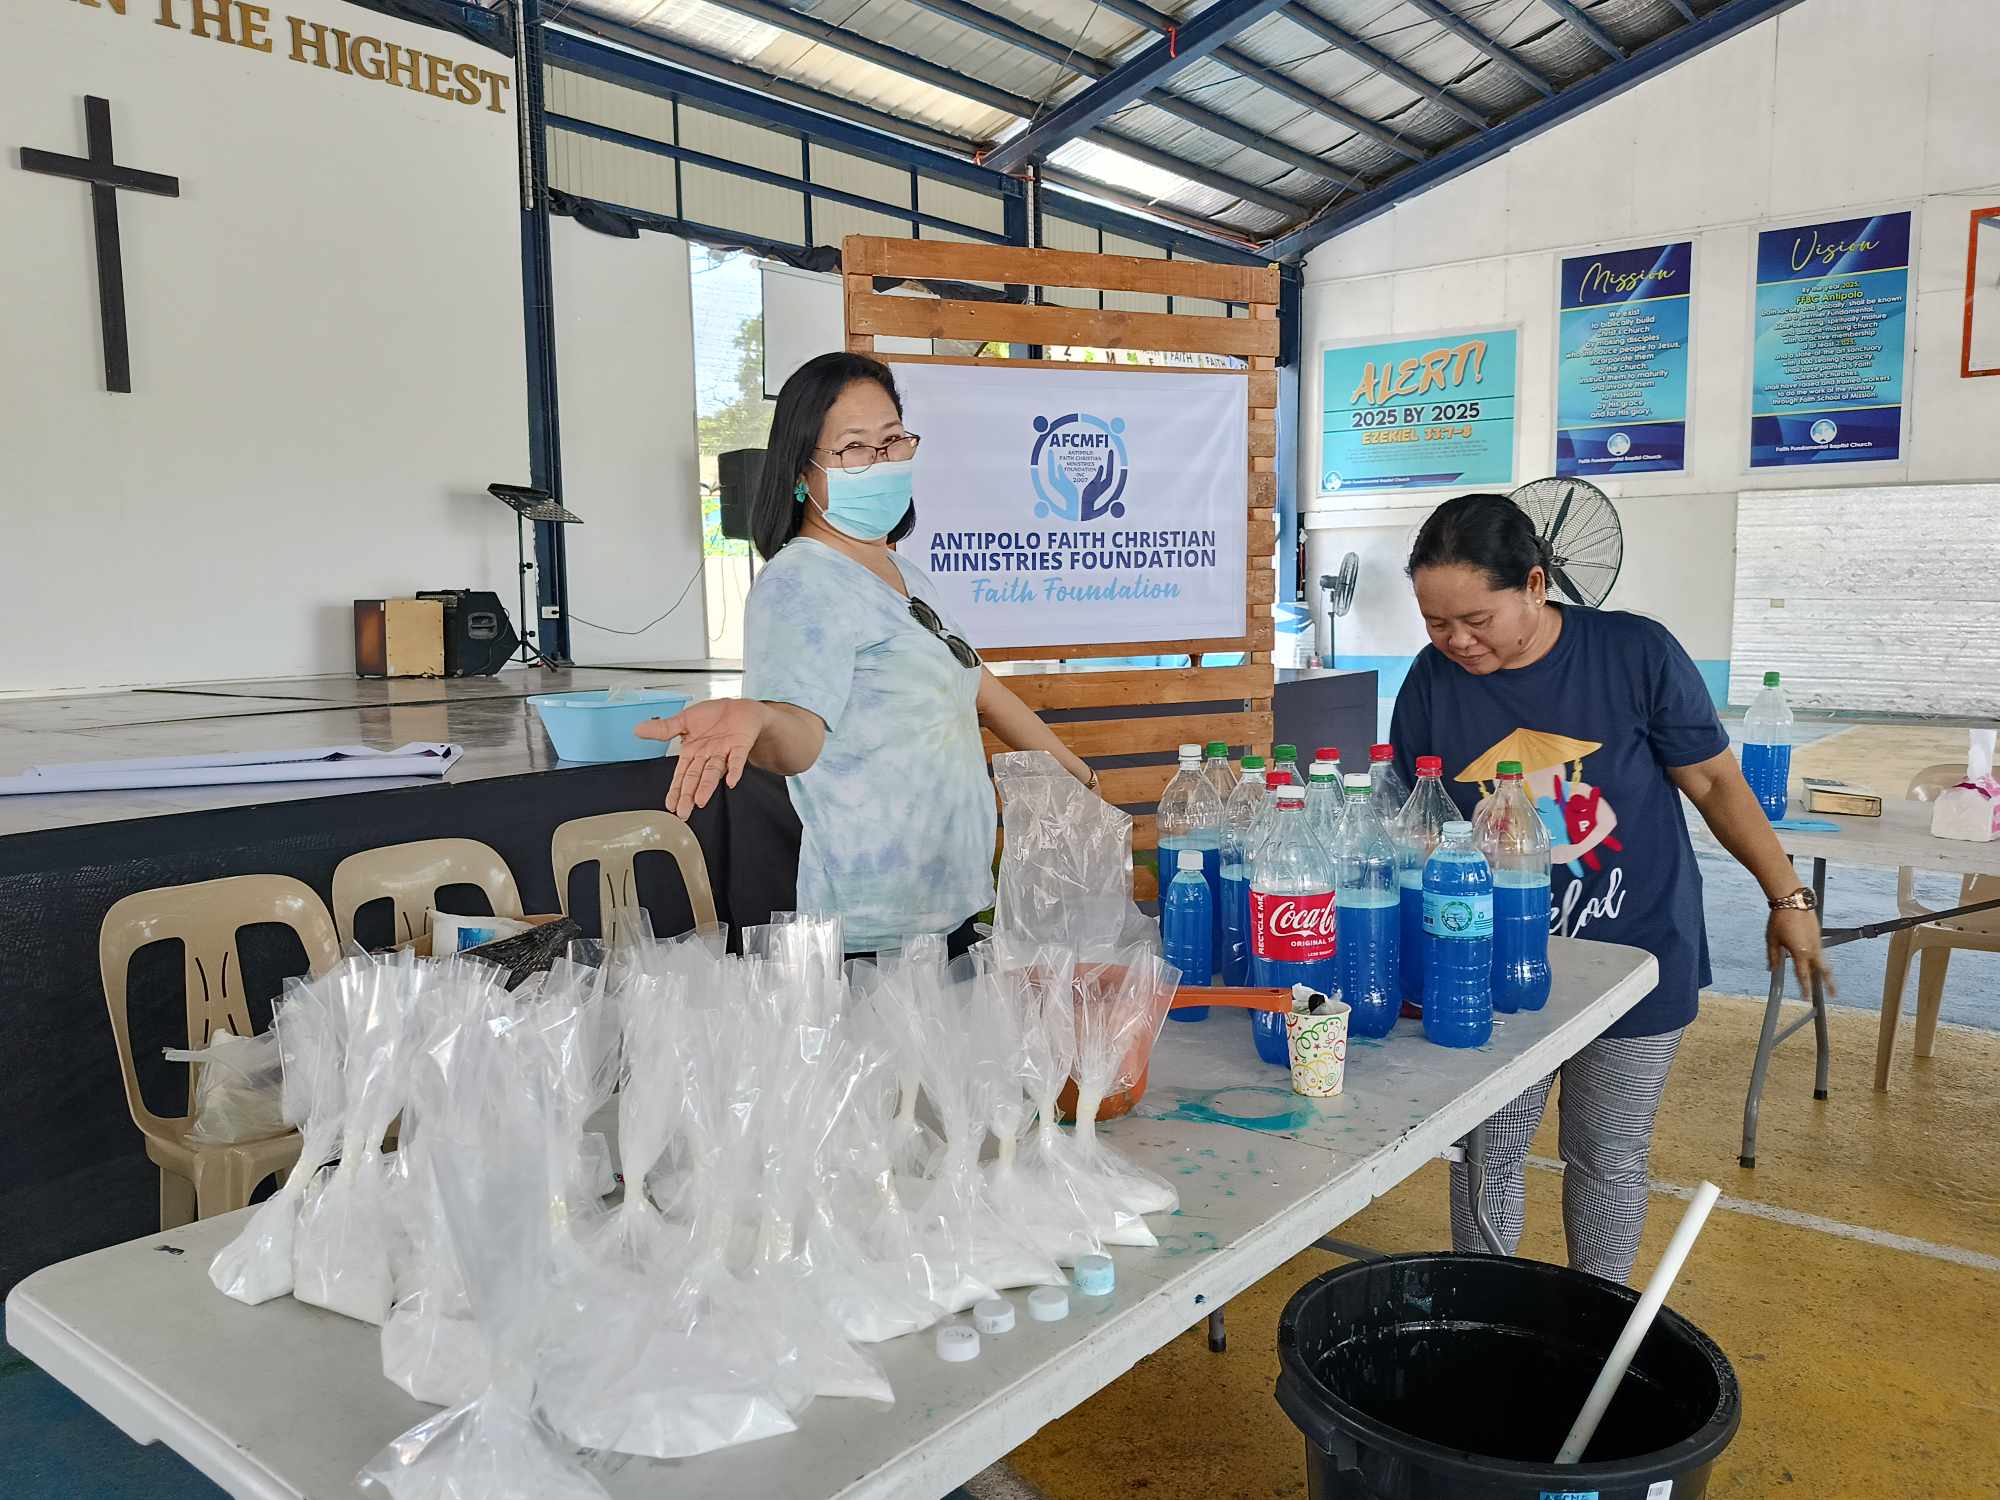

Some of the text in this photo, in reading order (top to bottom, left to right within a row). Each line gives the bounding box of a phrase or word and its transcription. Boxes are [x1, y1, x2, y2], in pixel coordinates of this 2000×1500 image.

[286, 15, 510, 114] HIGHEST
[1791, 230, 1880, 271] Vision
[1579, 262, 1676, 303] Mission
[1823, 290, 1864, 303] Antipolo
[1635, 315, 1655, 325] build
[1853, 320, 1879, 331] church
[1623, 325, 1650, 335] church
[1831, 329, 1877, 341] membership
[1206, 355, 1226, 367] FAITH
[1351, 339, 1488, 407] ALERT!
[1352, 402, 1480, 428] 2025 BY 2025
[1049, 433, 1109, 448] AFCMFI
[1361, 427, 1420, 446] EZEKIEL
[1850, 440, 1873, 448] Church
[930, 530, 1216, 551] ANTIPOLO FAITH CHRISTIAN
[930, 549, 1217, 573] MINISTRIES FOUNDATION
[969, 573, 1181, 604] Faith Foundation
[1257, 911, 1265, 954] RECYCLE
[1290, 938, 1327, 948] ORIGINAL
